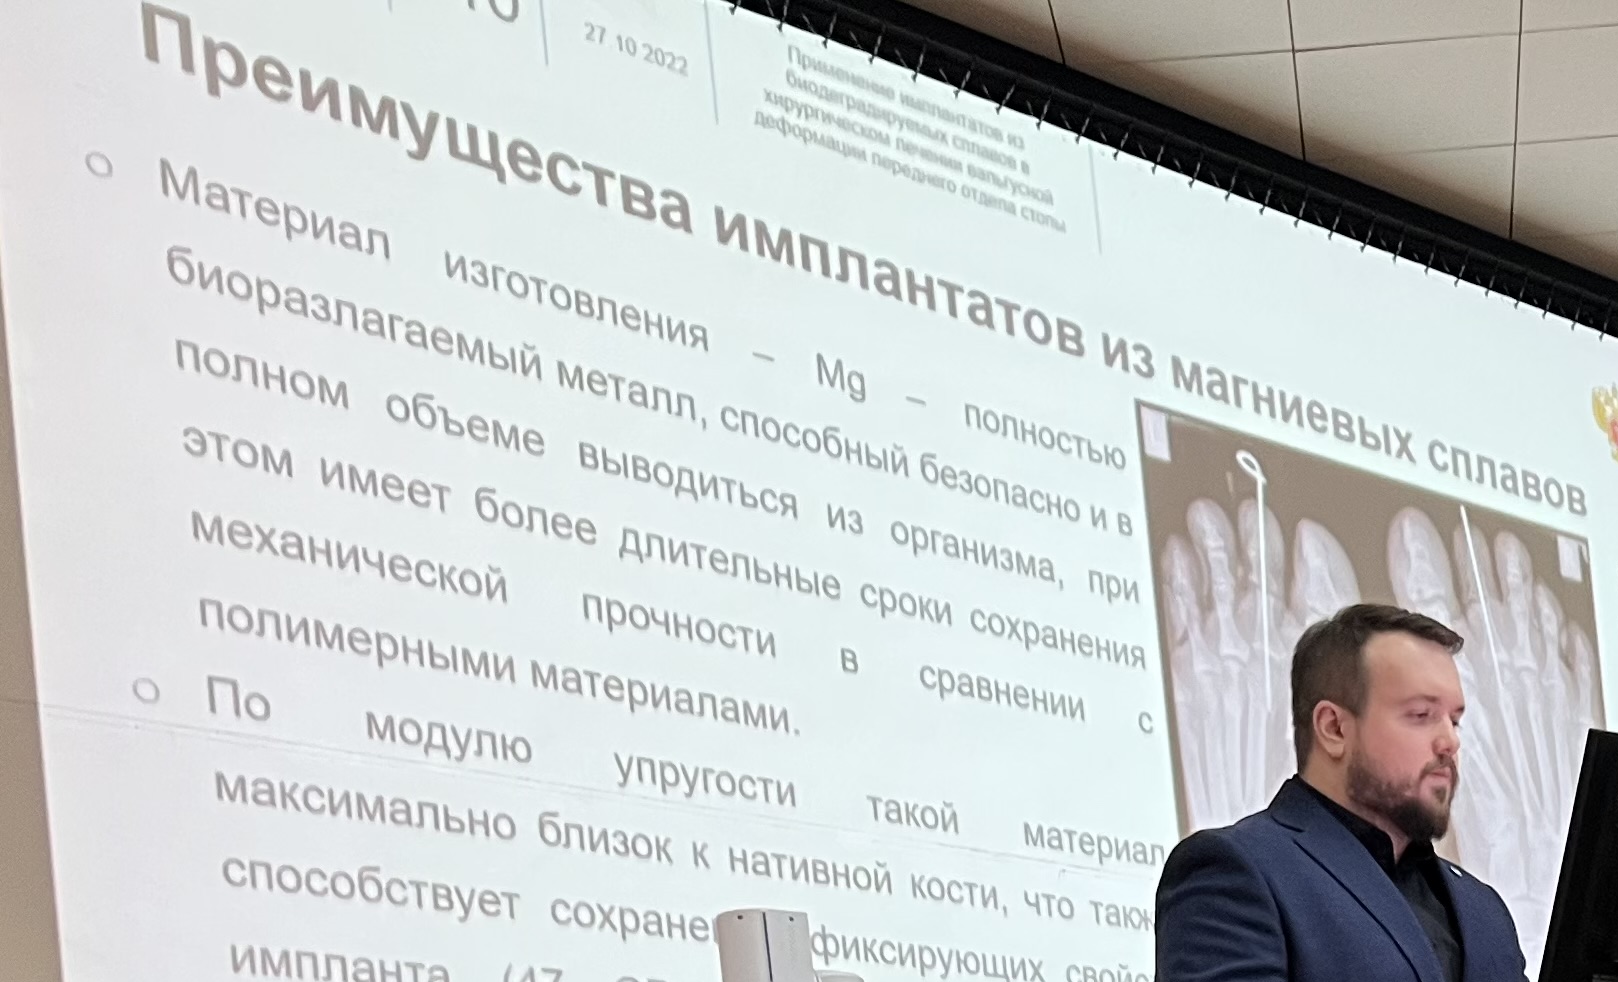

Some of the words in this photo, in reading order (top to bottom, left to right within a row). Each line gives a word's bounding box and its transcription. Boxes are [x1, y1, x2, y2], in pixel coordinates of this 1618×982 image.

[584, 21, 606, 44] 27
[616, 34, 637, 57] 10
[641, 42, 689, 77] 2022
[141, 1, 694, 234] Преимущества
[715, 205, 1086, 360] имплантатов
[1102, 331, 1155, 380] из
[1171, 355, 1416, 463] магниевых
[1428, 438, 1588, 516] сплавов
[755, 110, 866, 162] деформации
[1021, 205, 1066, 233] стопы
[158, 157, 390, 260] Материал
[444, 249, 709, 352] изготовления
[816, 352, 867, 402] Mg
[964, 402, 1126, 470] полностью
[167, 246, 541, 381] биоразлагаемый
[556, 355, 707, 429] металл,
[721, 404, 909, 477] способный
[920, 451, 1080, 523] безопасно
[1090, 506, 1108, 530] и
[1117, 512, 1132, 537] в
[175, 338, 348, 409] полном
[386, 392, 544, 456] объеме
[578, 441, 797, 518] выводиться
[827, 503, 863, 534] из
[891, 520, 1063, 590] организма,
[1089, 567, 1140, 604] при
[183, 426, 293, 478] этом
[320, 457, 451, 512] имеет
[474, 488, 596, 545] более
[618, 526, 841, 599] длительные
[860, 580, 952, 626] сроки
[970, 606, 1146, 670] сохранения
[191, 510, 507, 603] механической
[583, 593, 776, 658] прочности
[841, 647, 858, 673] в
[920, 664, 1084, 722] сравнении
[1138, 709, 1153, 734] с
[200, 598, 515, 684] полимерными
[531, 660, 800, 736] материалами.
[207, 675, 270, 721] По
[366, 711, 531, 763] модулю
[614, 753, 796, 807] упругости
[867, 795, 959, 834] такой
[1024, 822, 1165, 866] материал
[215, 770, 516, 839] максимально
[538, 812, 673, 865] близок
[692, 841, 710, 869] к
[729, 845, 892, 894] нативной
[911, 874, 1008, 914] кости,
[1024, 890, 1074, 920] что
[1090, 900, 1154, 931] такж
[223, 857, 520, 923] способствует
[551, 897, 717, 943] сохране
